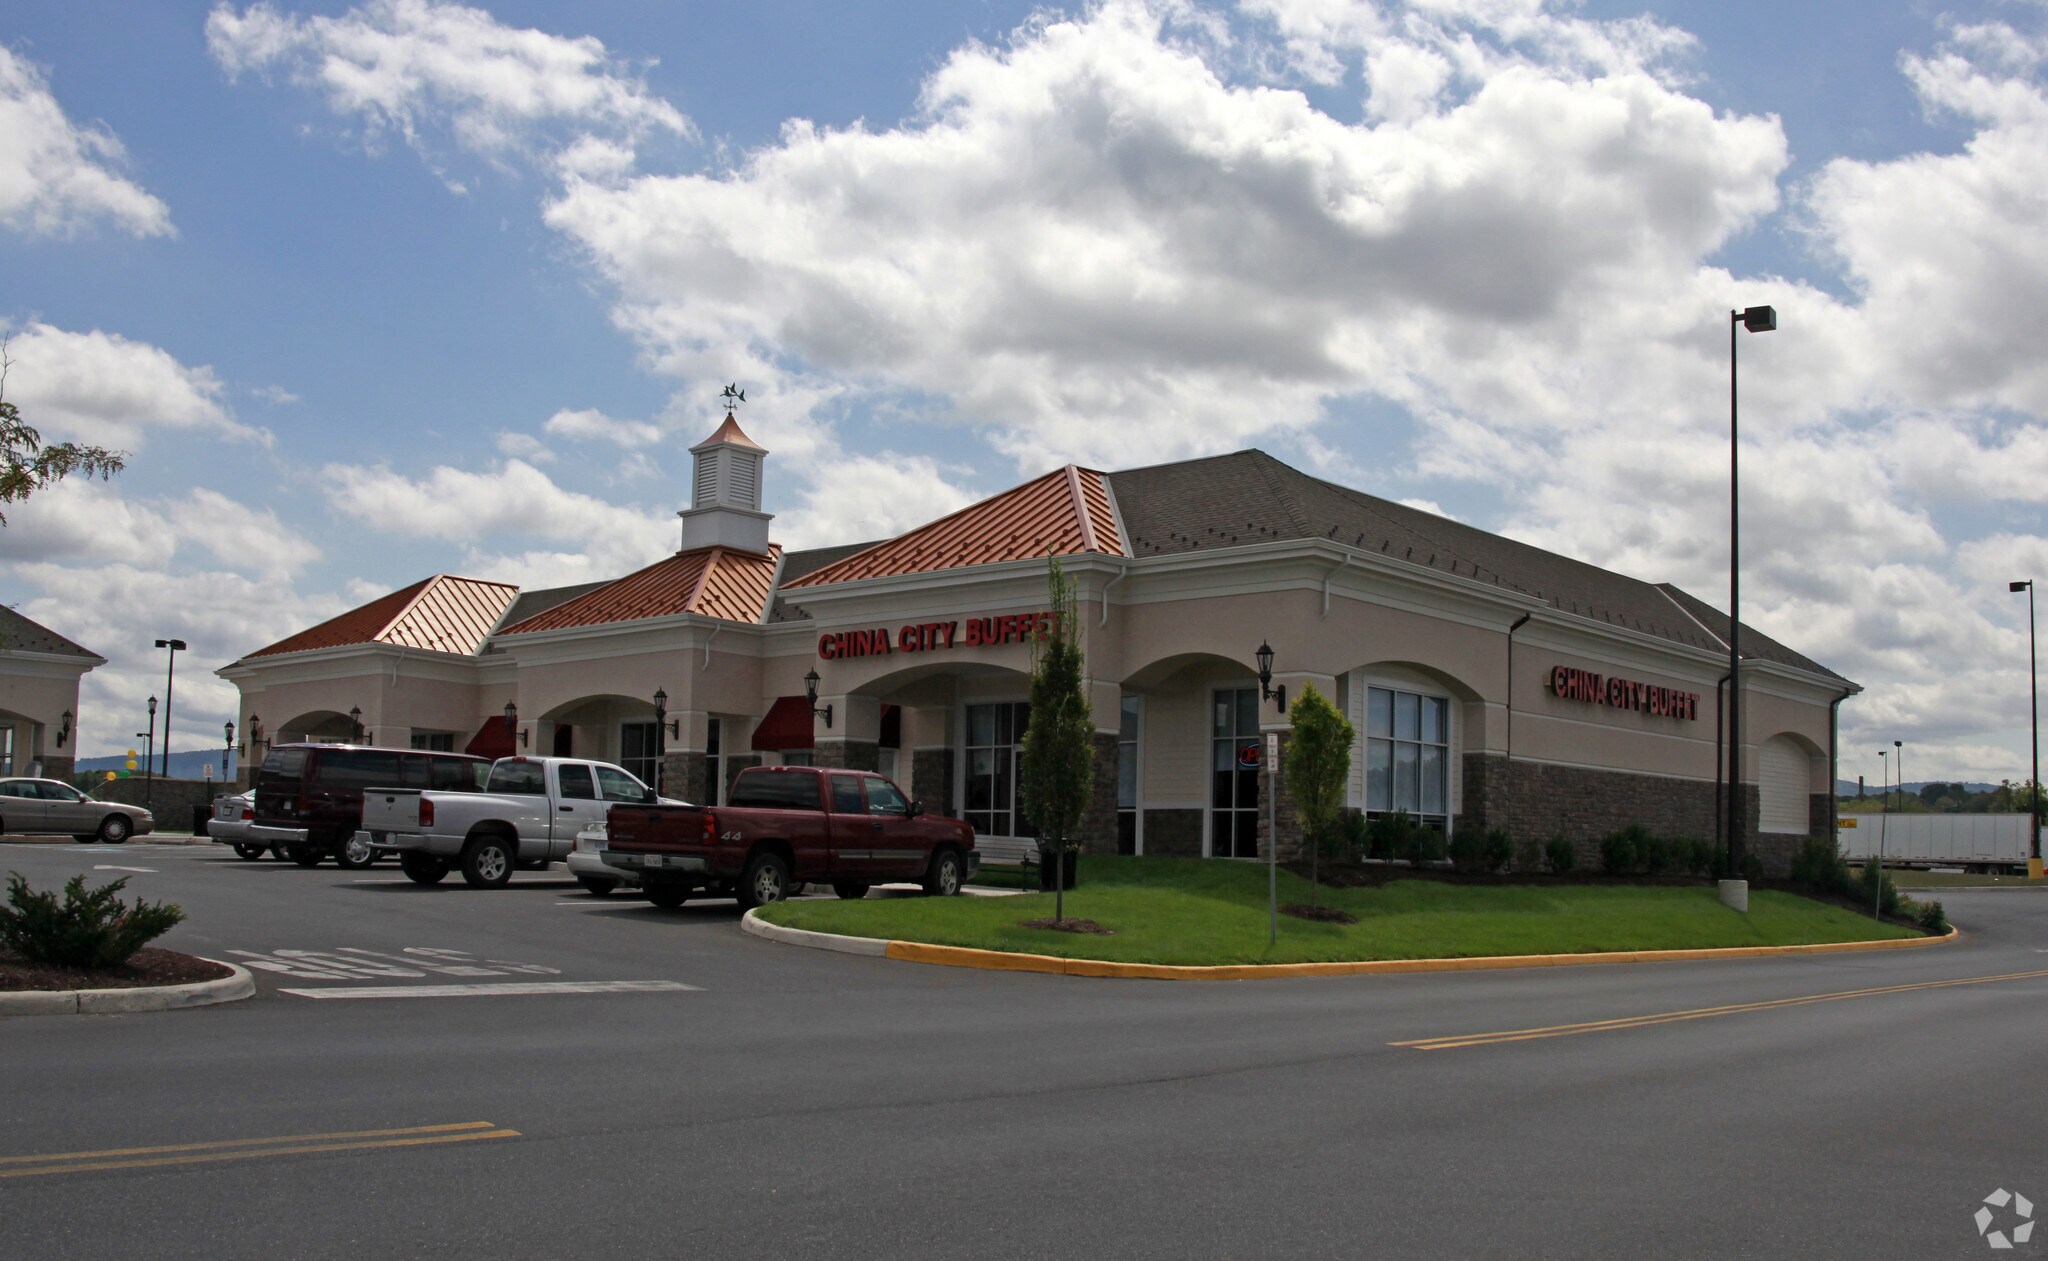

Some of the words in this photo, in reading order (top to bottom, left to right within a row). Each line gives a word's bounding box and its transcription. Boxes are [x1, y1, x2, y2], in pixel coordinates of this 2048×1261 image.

[818, 628, 892, 660] CHINA
[898, 620, 958, 652] CITY
[1551, 665, 1607, 705] CHINA
[1607, 676, 1646, 711] CITY
[1647, 685, 1700, 721] BUFFET
